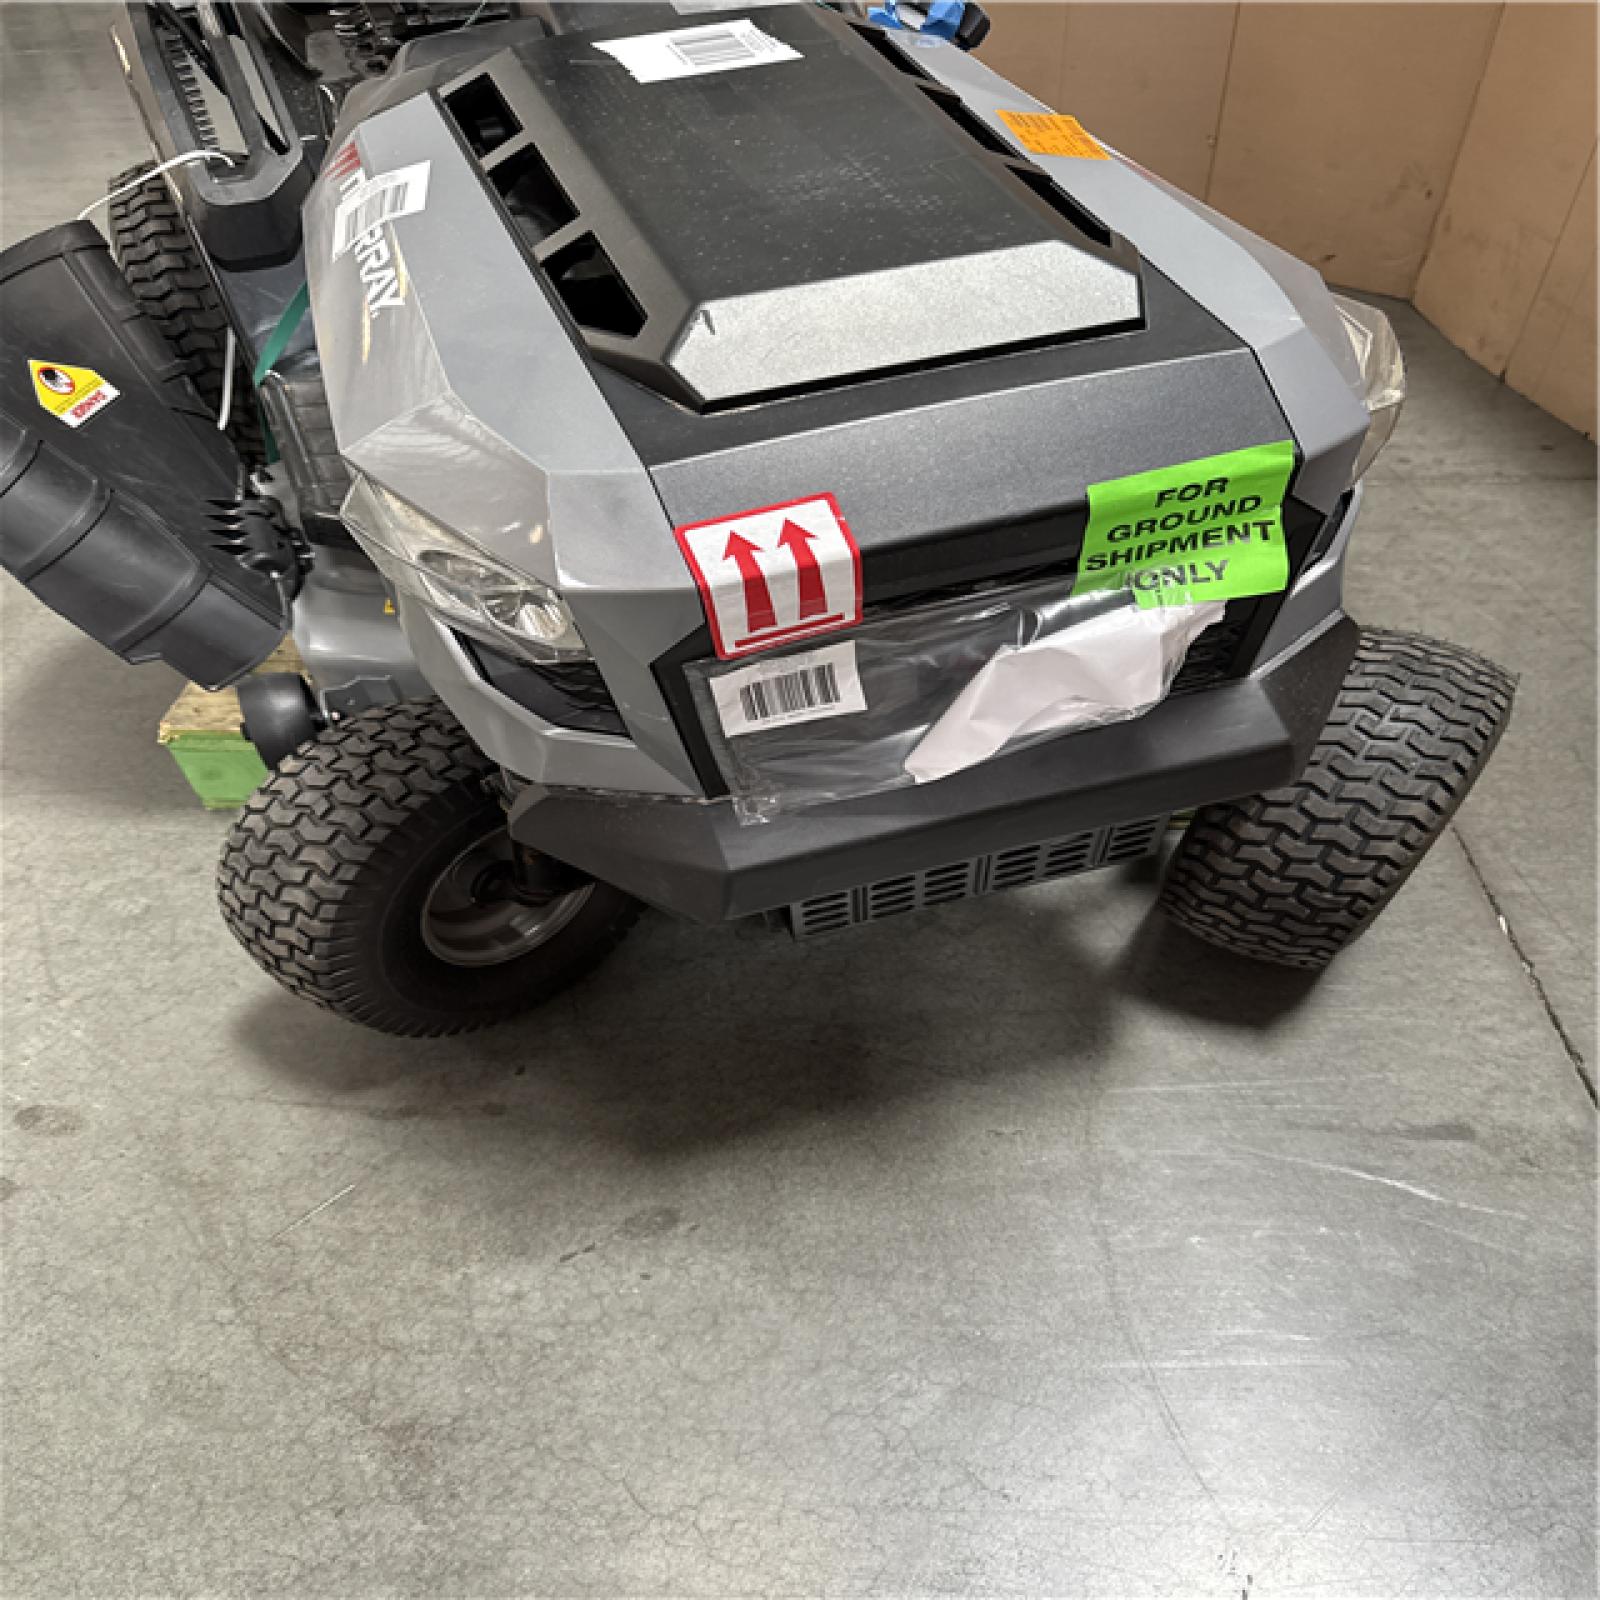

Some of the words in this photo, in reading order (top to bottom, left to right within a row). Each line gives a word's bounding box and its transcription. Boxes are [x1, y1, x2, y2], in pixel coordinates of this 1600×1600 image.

[1154, 477, 1229, 508] FOR
[1106, 495, 1262, 543] GROUND
[1085, 520, 1275, 571] SHIPMENT
[1134, 559, 1229, 591] ONLY
